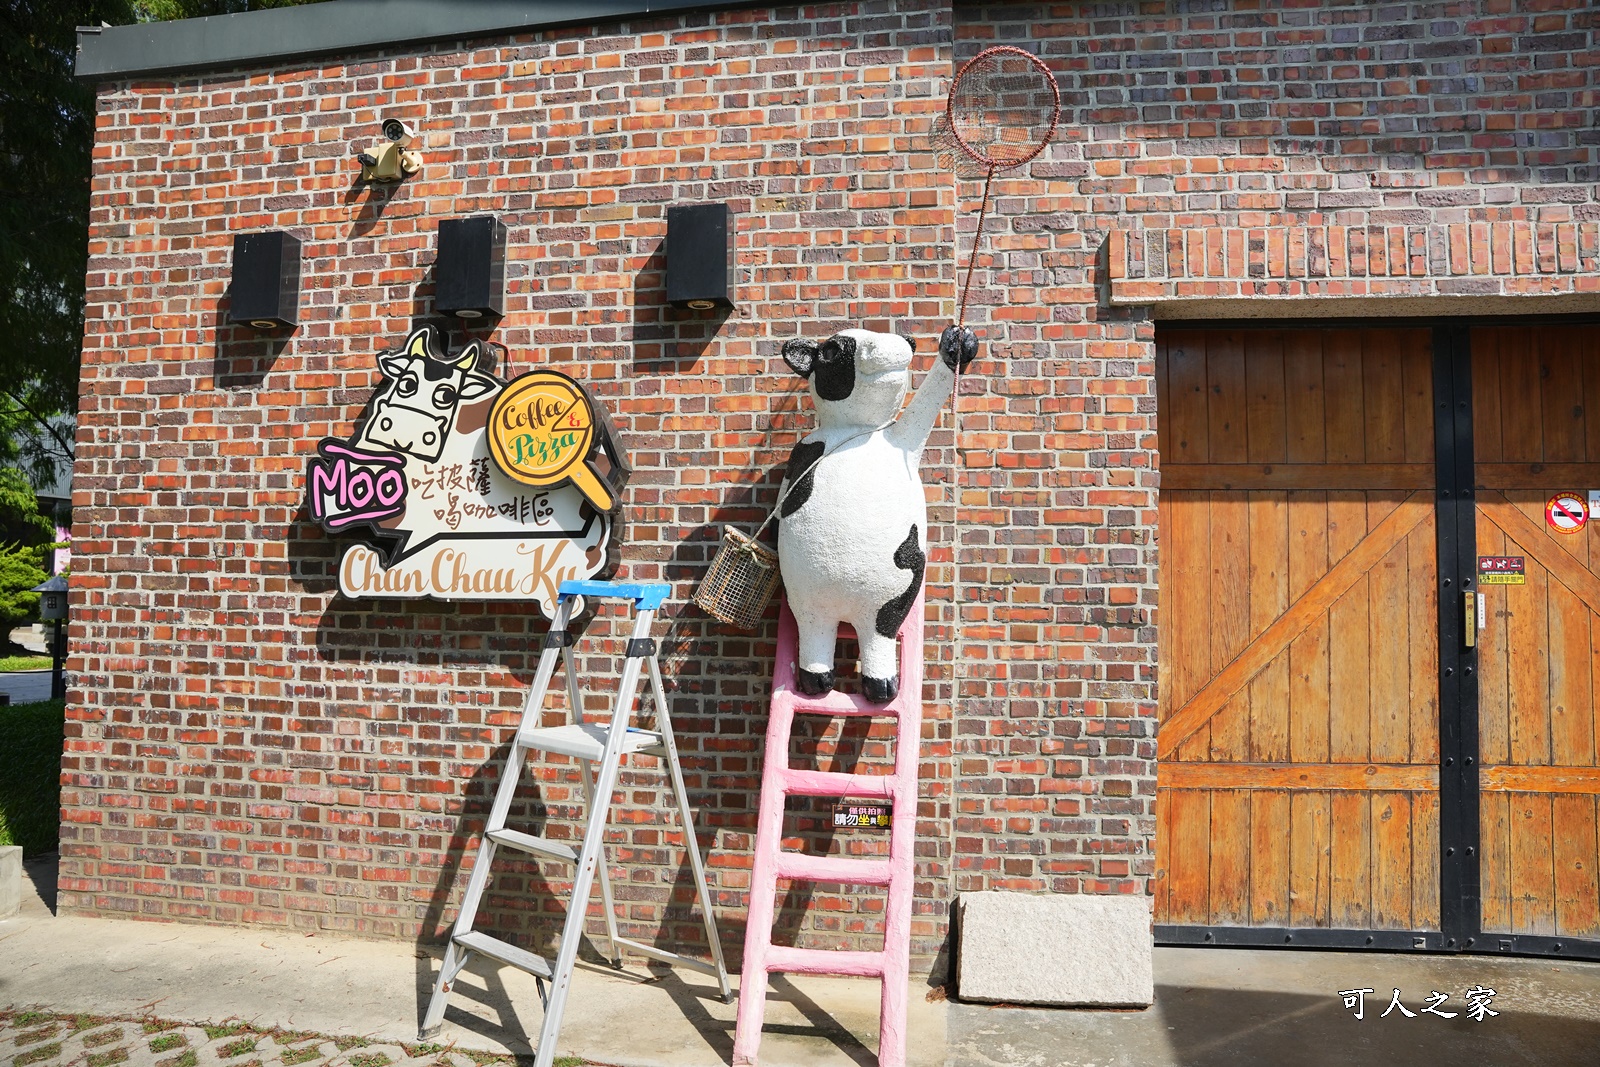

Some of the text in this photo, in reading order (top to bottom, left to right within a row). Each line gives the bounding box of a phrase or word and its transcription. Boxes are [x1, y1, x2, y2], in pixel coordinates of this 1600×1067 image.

[502, 397, 585, 431] Coffee &
[508, 430, 580, 466] Pizza
[312, 458, 405, 517] Moo
[411, 457, 492, 499] 吃披薩
[433, 491, 554, 530] 喝咖啡區
[343, 547, 430, 594] Chan
[430, 547, 520, 595] Chau
